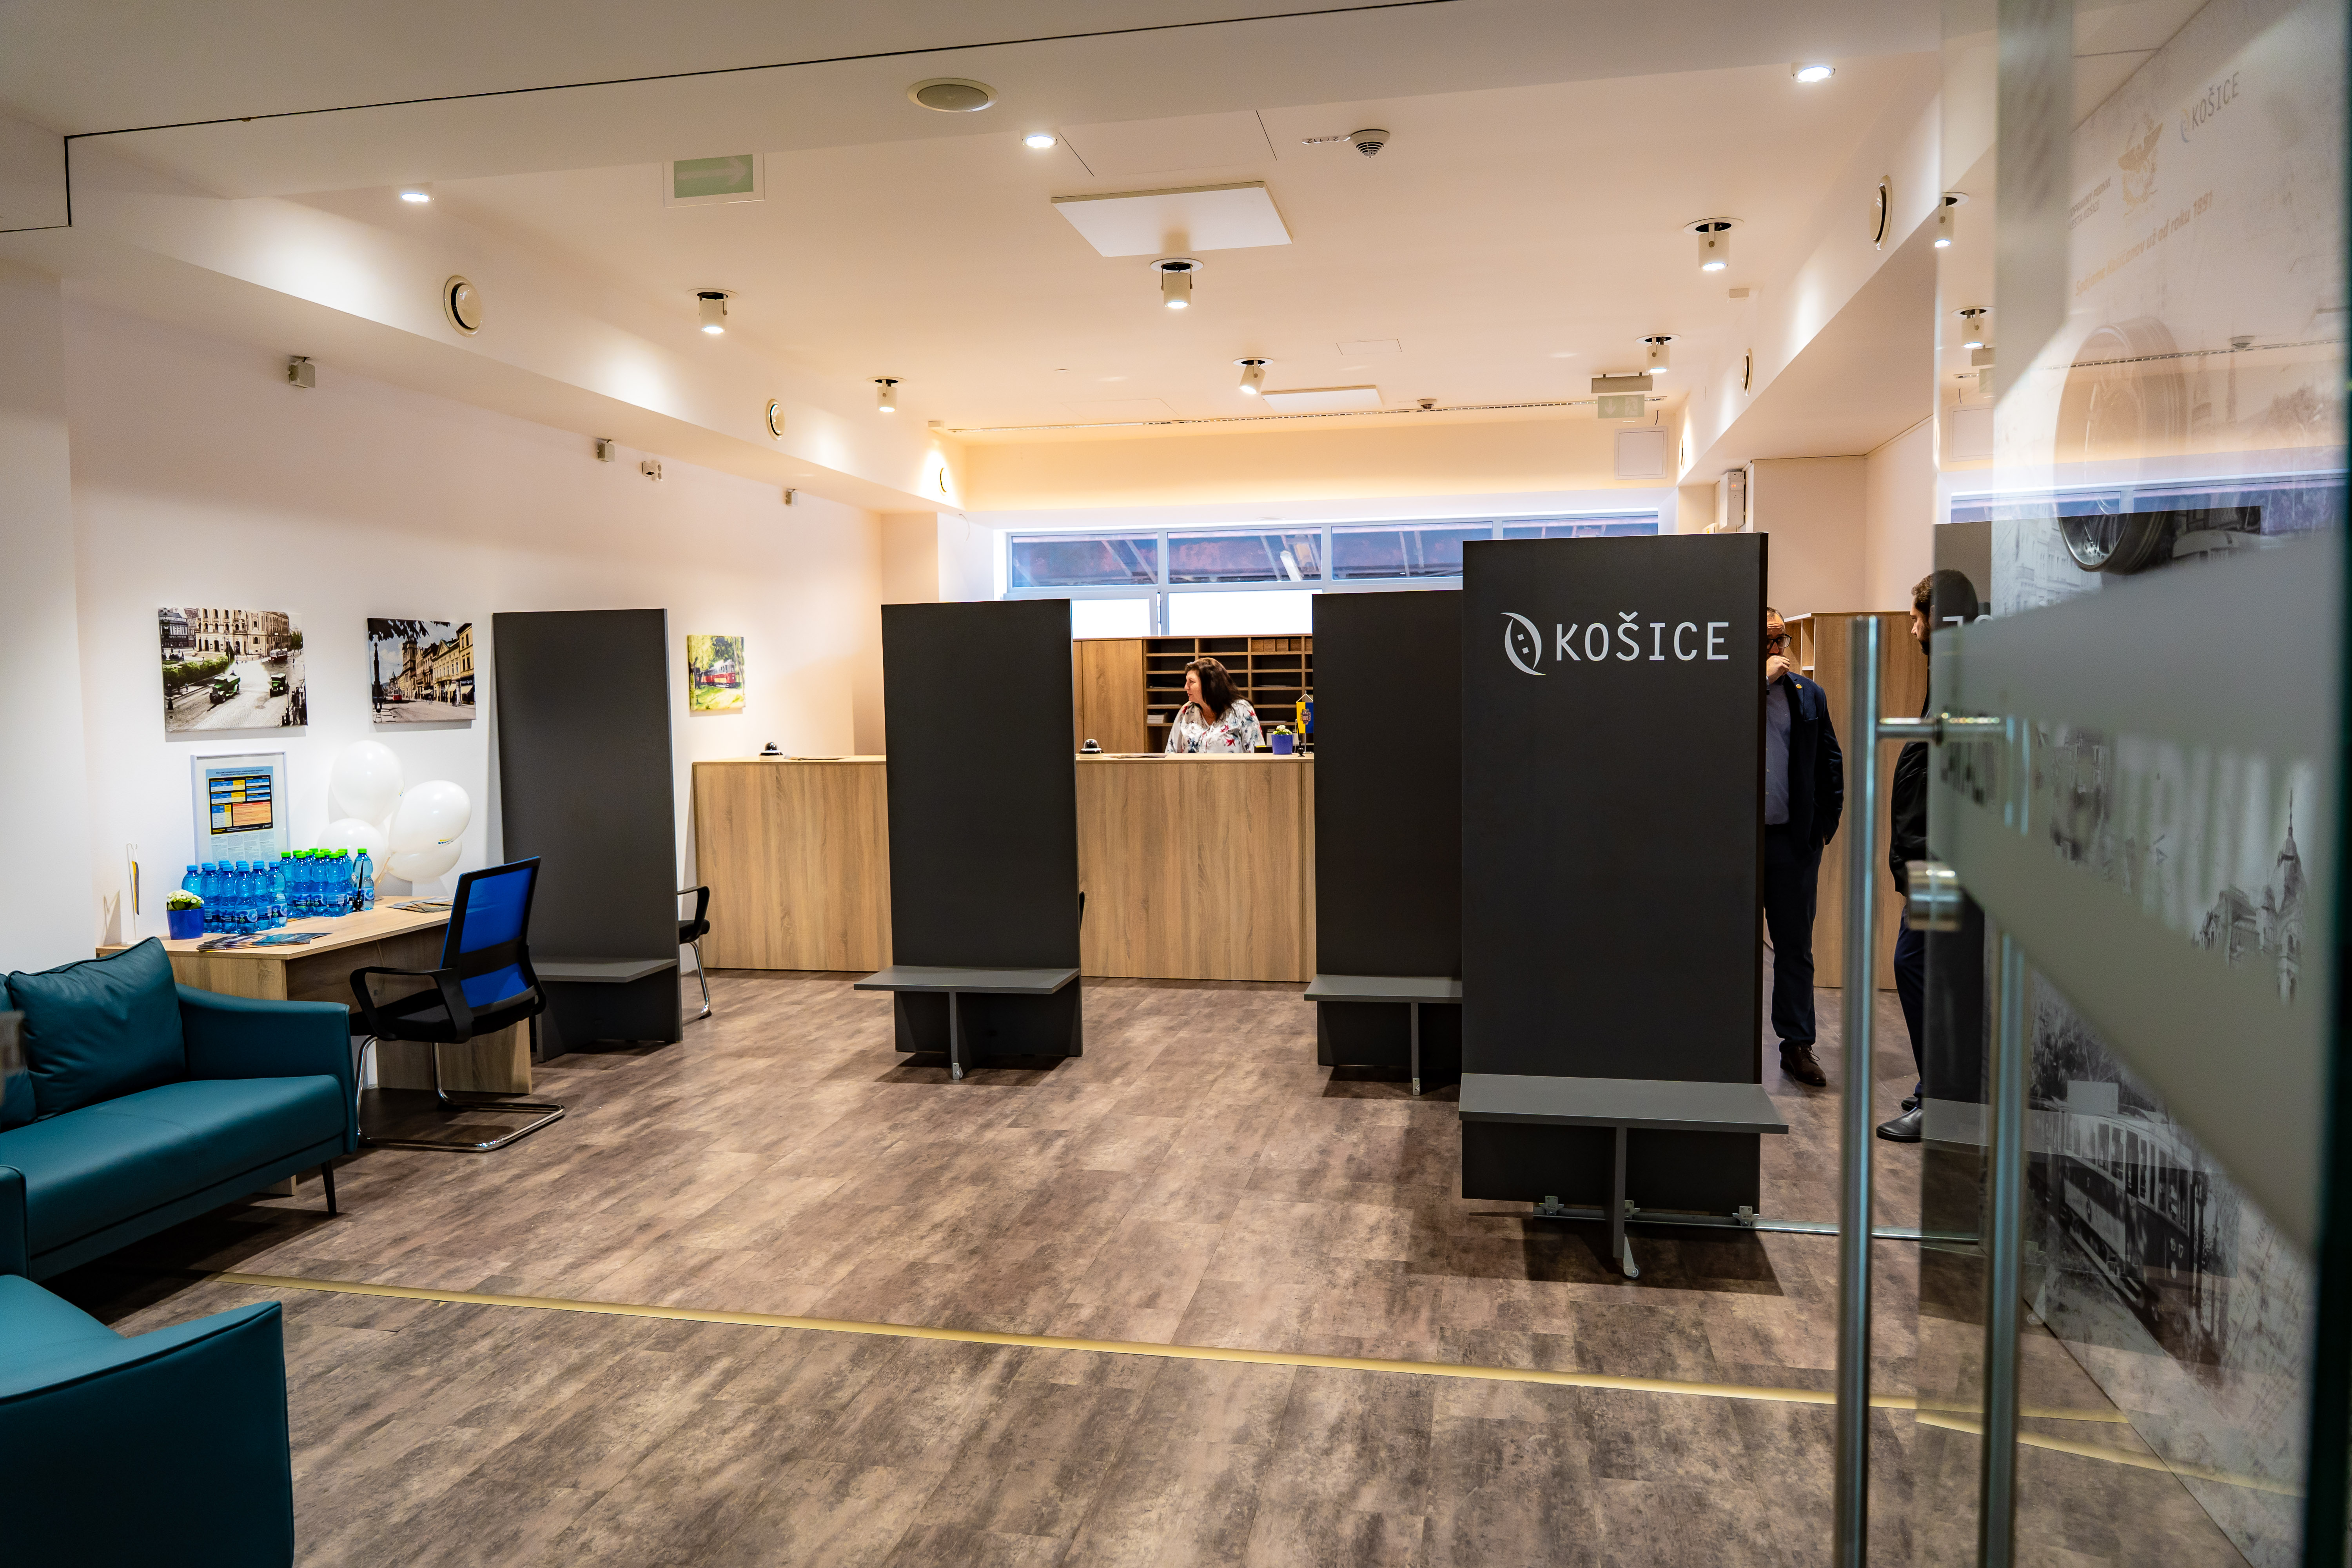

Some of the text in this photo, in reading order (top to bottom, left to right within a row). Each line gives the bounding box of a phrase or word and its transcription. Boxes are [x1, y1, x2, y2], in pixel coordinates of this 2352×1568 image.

[2192, 70, 2239, 130] KOŠICE
[2158, 218, 2169, 241] od
[2171, 208, 2190, 234] roku
[2193, 189, 2213, 218] 1891
[1555, 611, 1730, 661] KOŠICE
